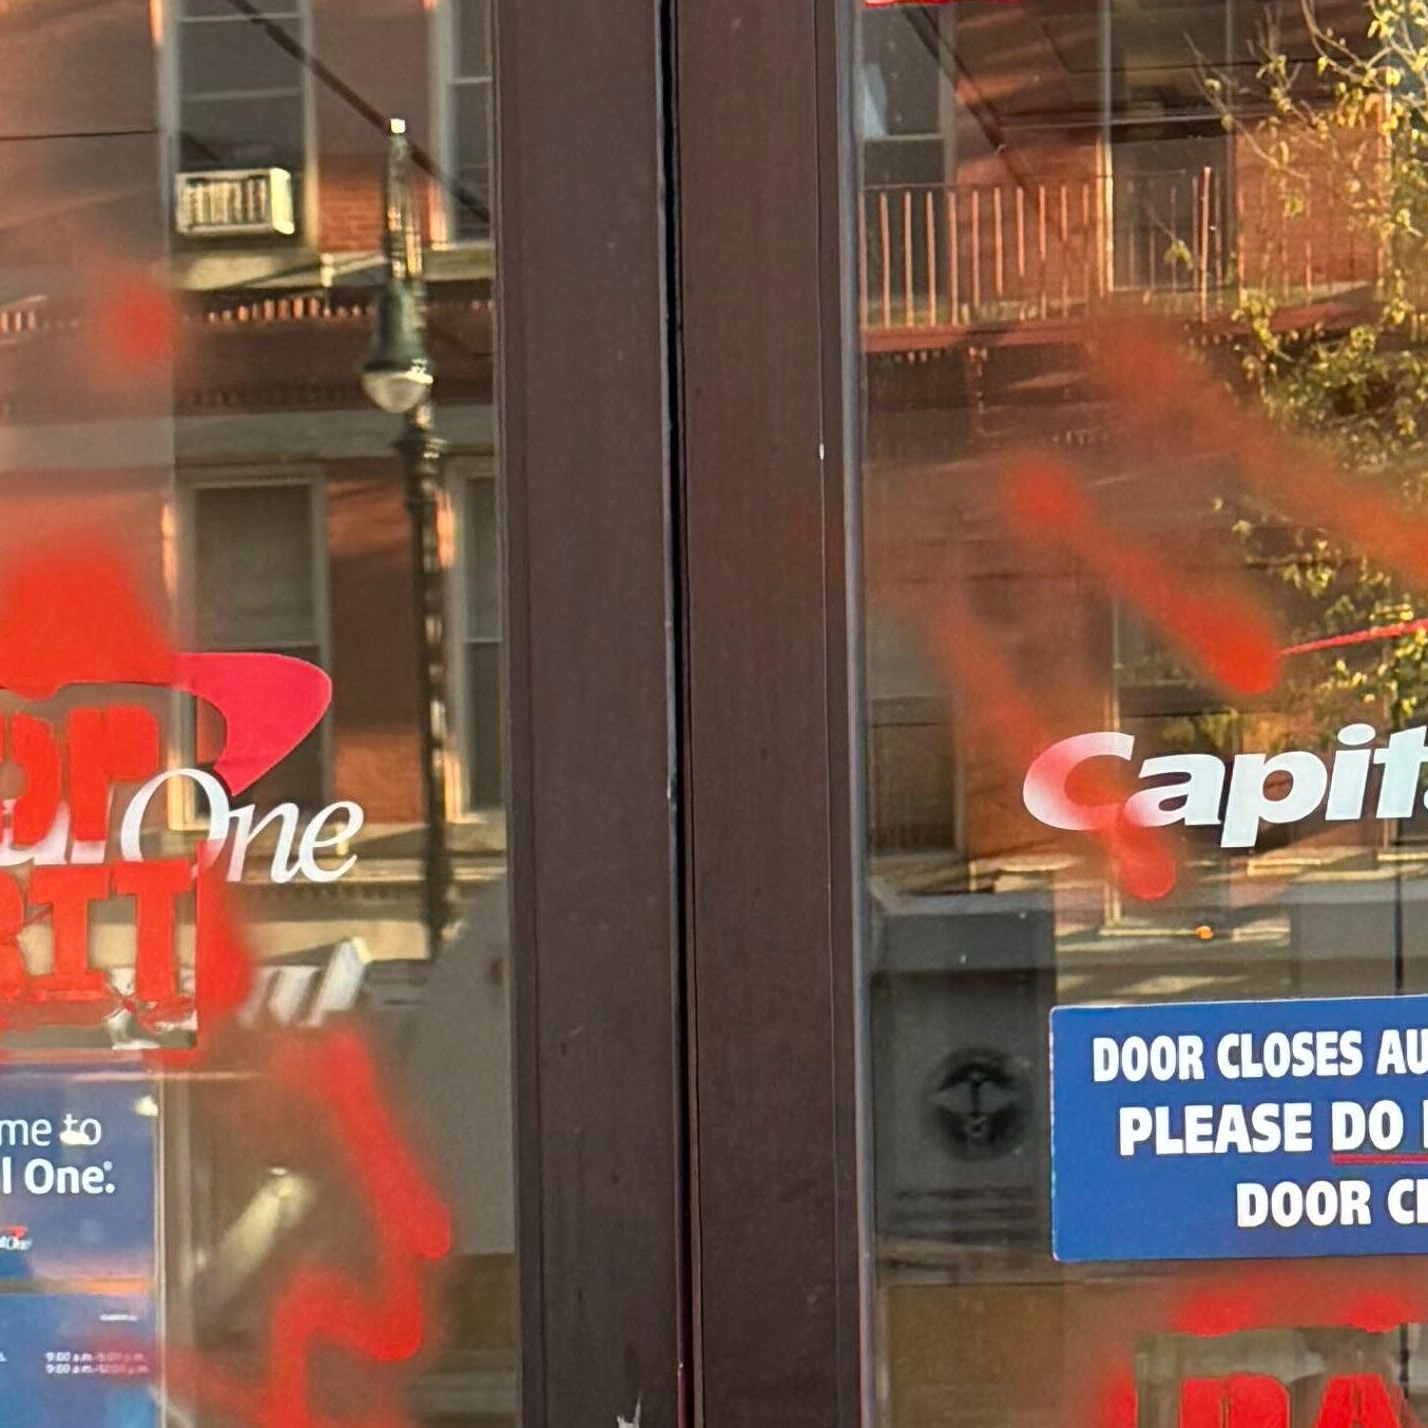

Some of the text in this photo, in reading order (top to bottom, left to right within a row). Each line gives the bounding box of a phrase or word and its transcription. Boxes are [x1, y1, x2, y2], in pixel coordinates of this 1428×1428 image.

[1093, 1034, 1204, 1082] DOOR
[1217, 1030, 1363, 1078] CLOSES
[60, 1113, 102, 1146] to
[1119, 1102, 1312, 1156] PLEASE
[1331, 1100, 1404, 1152] DO
[1236, 1180, 1371, 1228] DOOR
